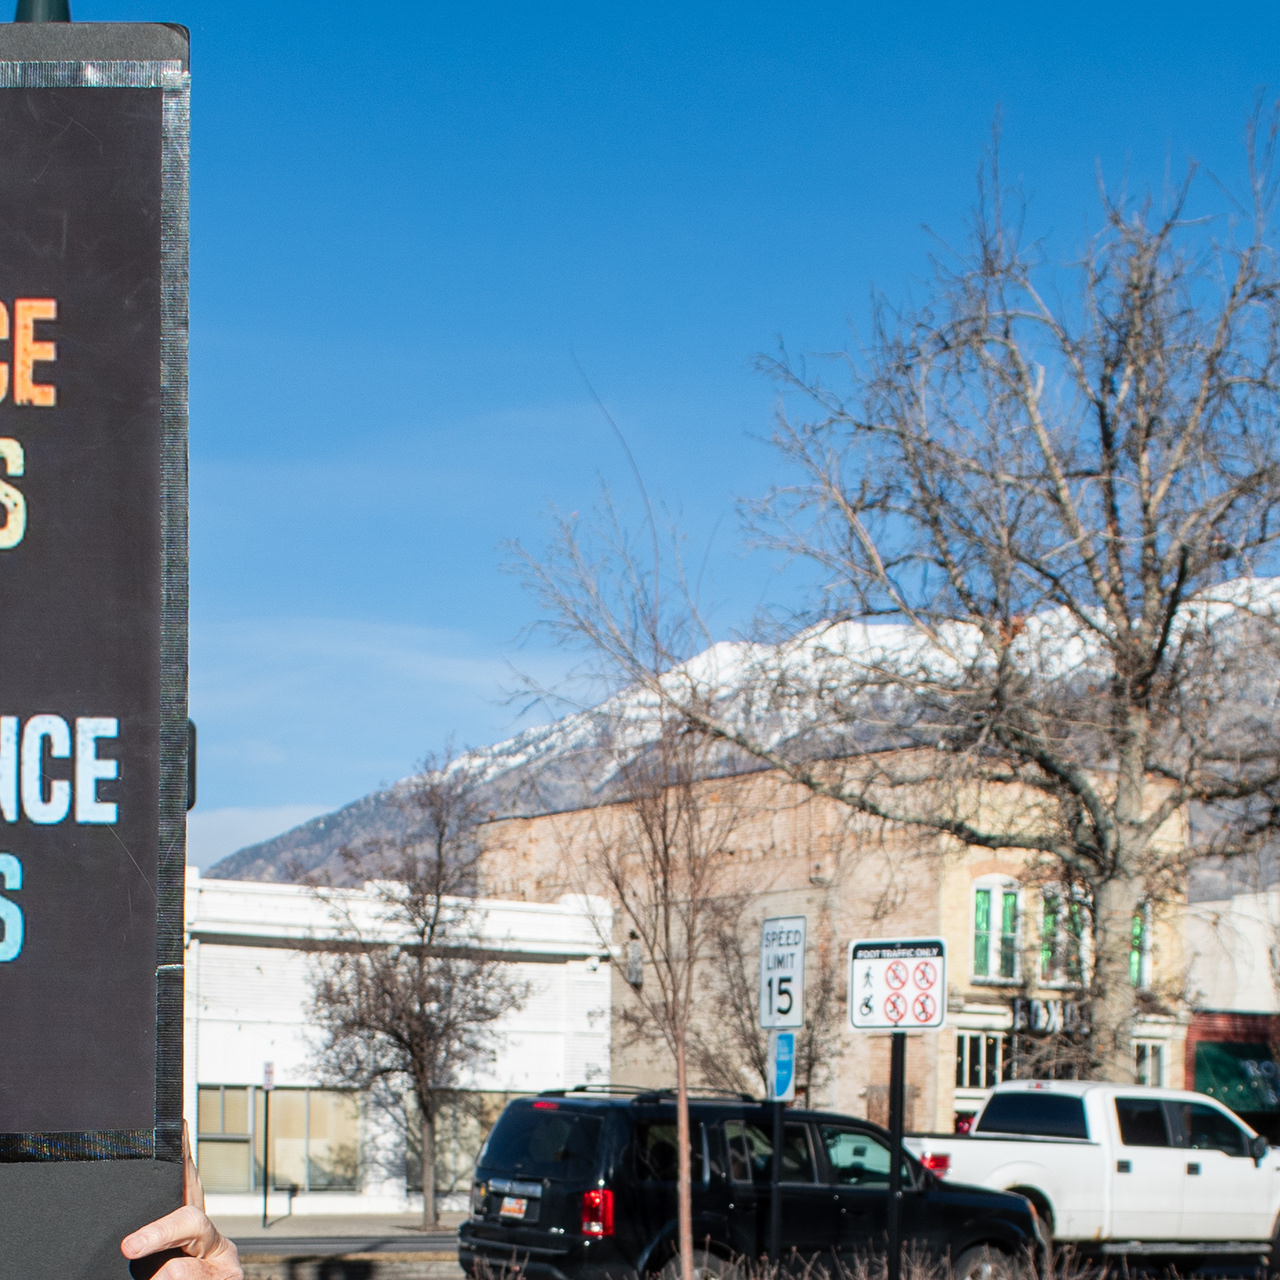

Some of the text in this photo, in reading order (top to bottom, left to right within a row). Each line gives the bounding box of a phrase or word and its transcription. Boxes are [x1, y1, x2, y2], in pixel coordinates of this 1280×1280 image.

[765, 930, 802, 948] SPEED
[767, 953, 796, 971] LIMIT
[857, 947, 939, 959] FOOT TRAFFIC ONLY
[767, 976, 793, 1015] 15
